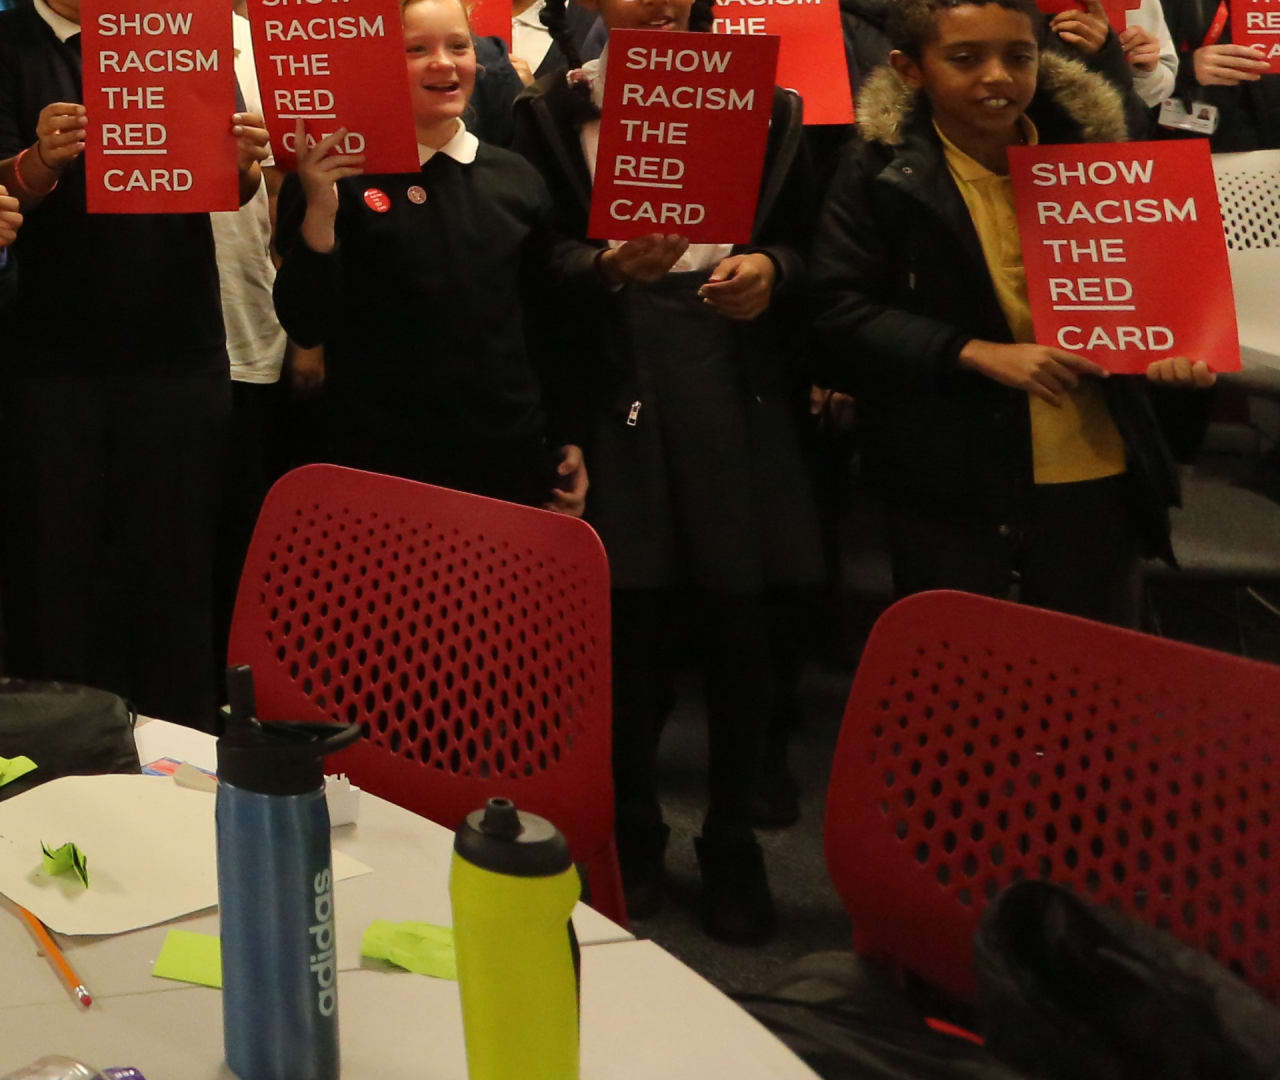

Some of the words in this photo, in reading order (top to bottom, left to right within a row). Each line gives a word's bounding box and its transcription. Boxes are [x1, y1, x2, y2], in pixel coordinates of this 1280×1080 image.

[98, 13, 192, 35] SHOW
[100, 50, 218, 72] RACISM
[626, 48, 732, 72] SHOW
[101, 87, 164, 109] THE
[623, 84, 754, 110] RACISM
[103, 124, 166, 145] RED
[621, 120, 688, 144] THE
[615, 155, 684, 179] RED
[1032, 160, 1153, 186] SHOW
[104, 169, 192, 191] CARD
[610, 200, 704, 224] CARD
[1038, 198, 1197, 224] RACISM
[1043, 239, 1126, 262] THE
[1049, 278, 1132, 301] RED
[1057, 326, 1174, 350] CARD
[309, 868, 336, 1017] adidas
